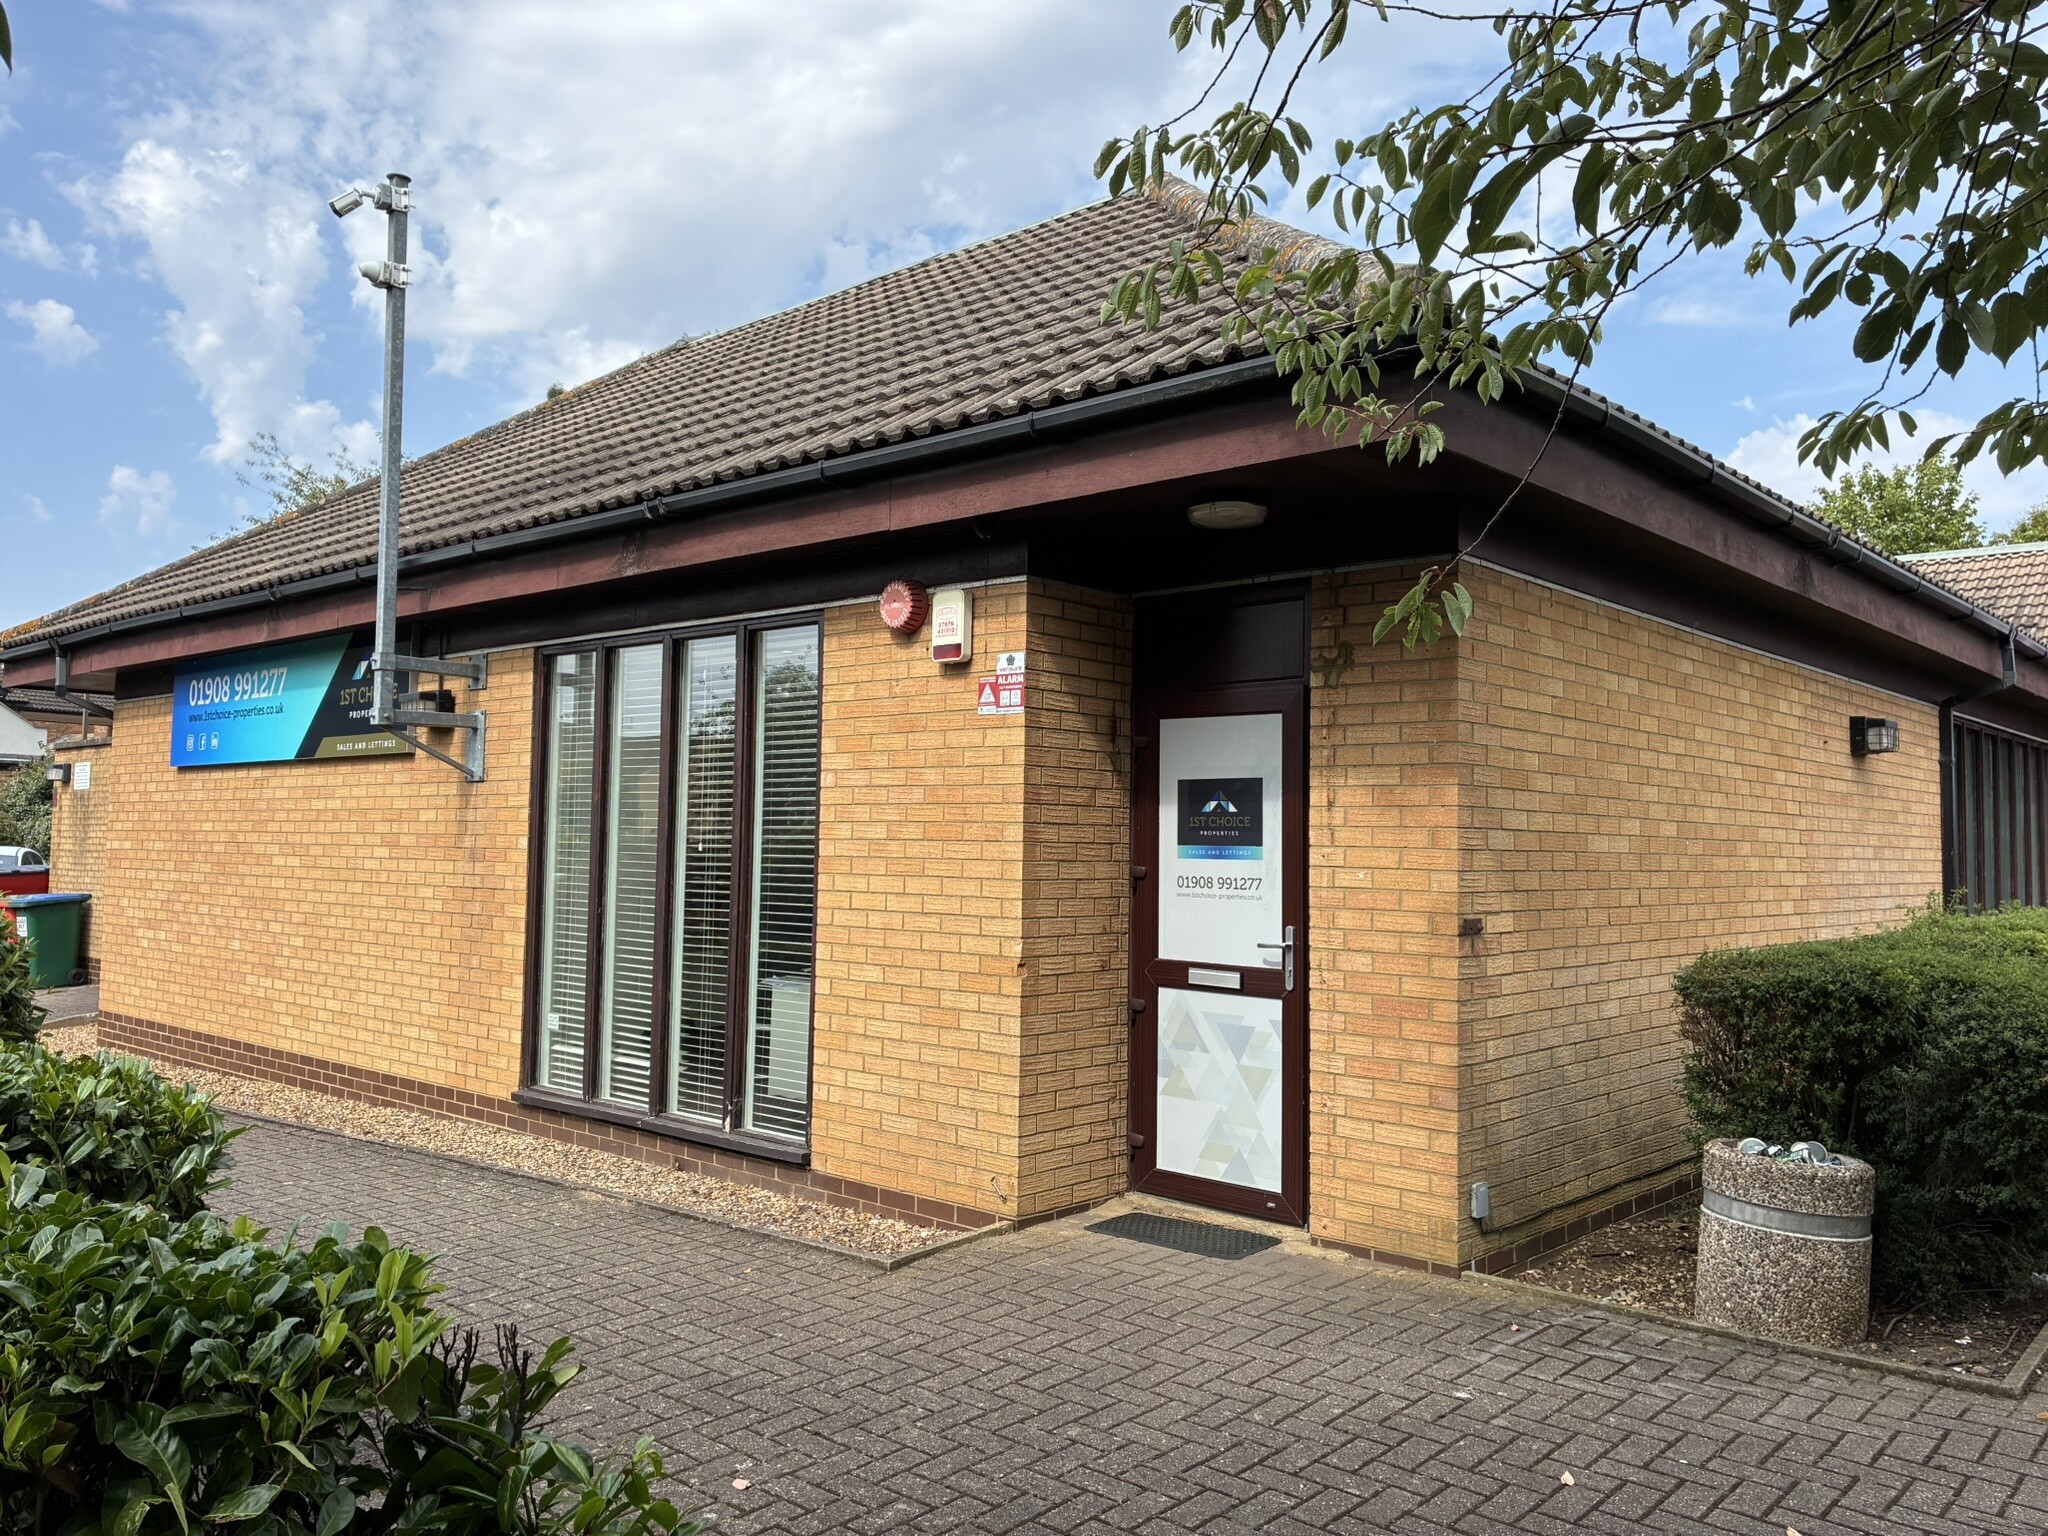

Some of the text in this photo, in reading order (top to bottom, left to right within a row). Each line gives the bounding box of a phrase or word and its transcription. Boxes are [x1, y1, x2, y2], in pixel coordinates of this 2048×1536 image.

[189, 666, 288, 707] 01908 991277
[997, 674, 1024, 685] ALARM
[339, 682, 398, 706] 1ST CHE
[188, 702, 285, 723] www.1stchoice-properties.co.uk
[336, 743, 353, 751] SALES
[367, 739, 396, 749] LETTINGS
[1189, 816, 1251, 827] 1ST CHOICE
[1177, 875, 1263, 891] 01908 991277
[1176, 892, 1264, 901] www.1stchoice-properties.co.uk
